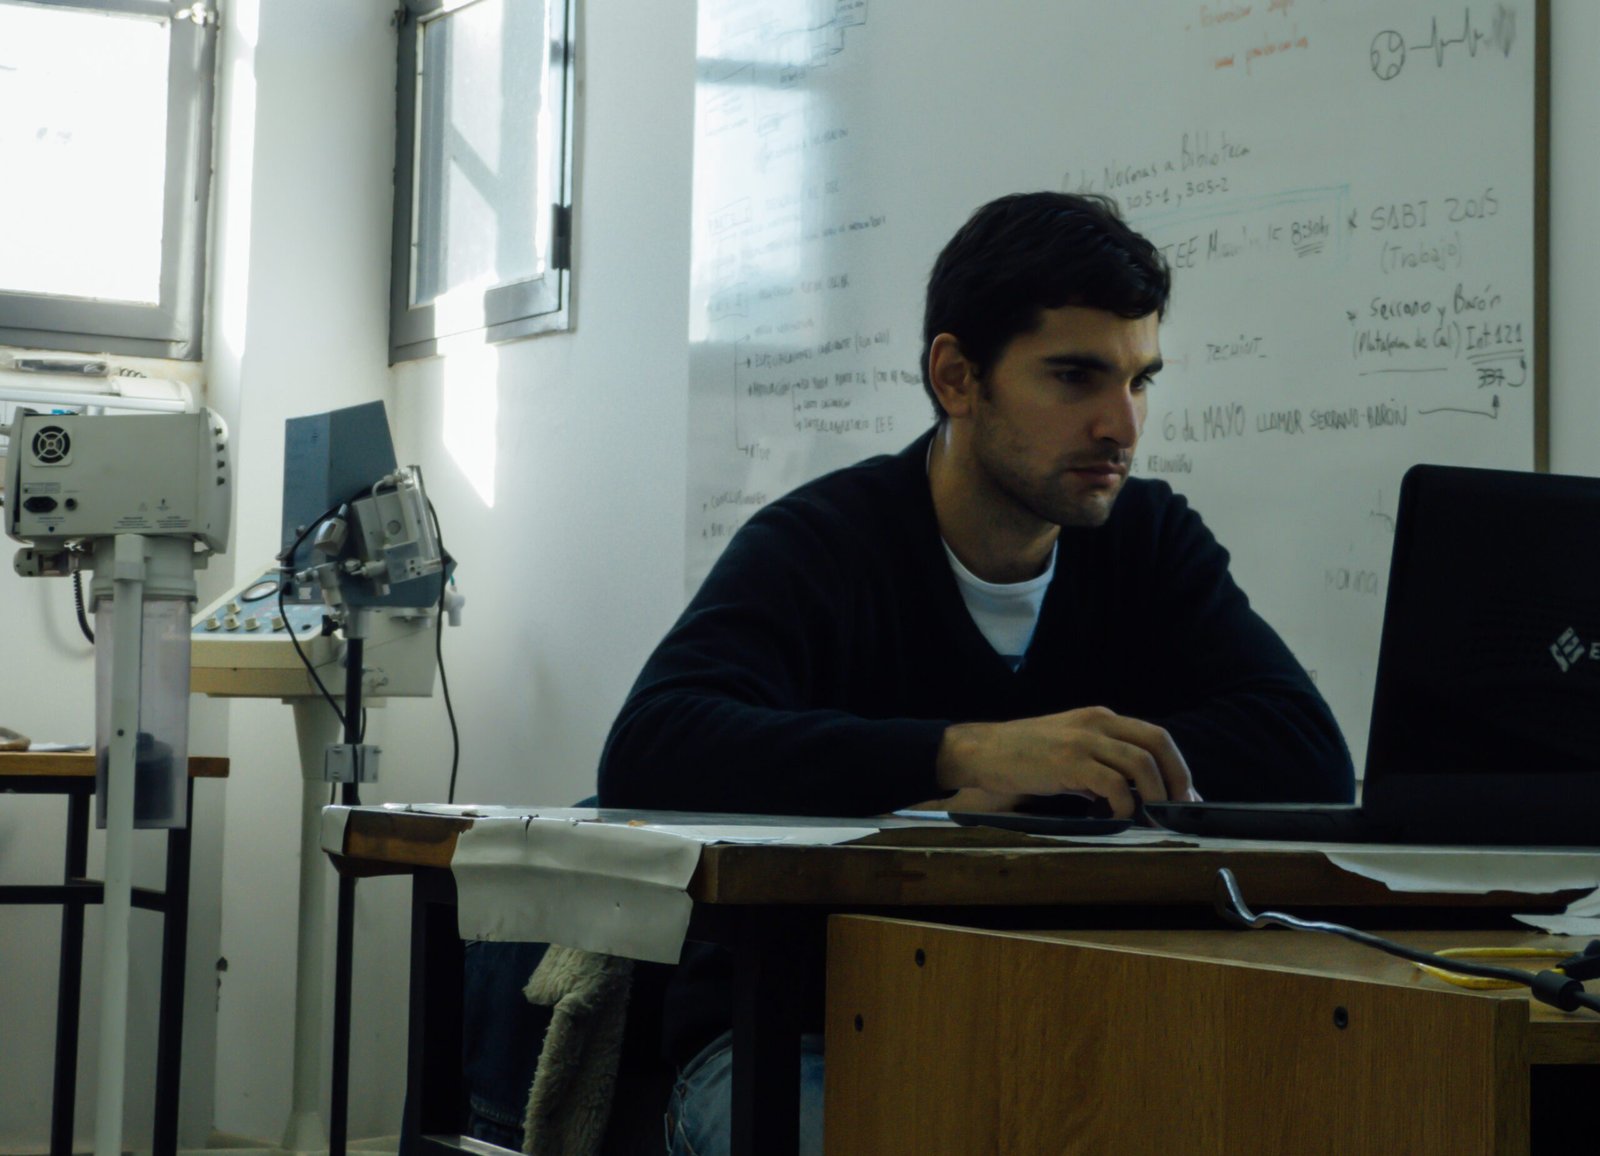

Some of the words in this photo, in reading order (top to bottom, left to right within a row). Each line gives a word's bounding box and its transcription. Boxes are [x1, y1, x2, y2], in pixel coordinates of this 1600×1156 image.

[1181, 131, 1250, 172] Biblioteca
[1370, 200, 1428, 231] SABI
[1444, 187, 1498, 223] 2015
[1161, 410, 1176, 442] 6
[1203, 402, 1247, 442] MAYO
